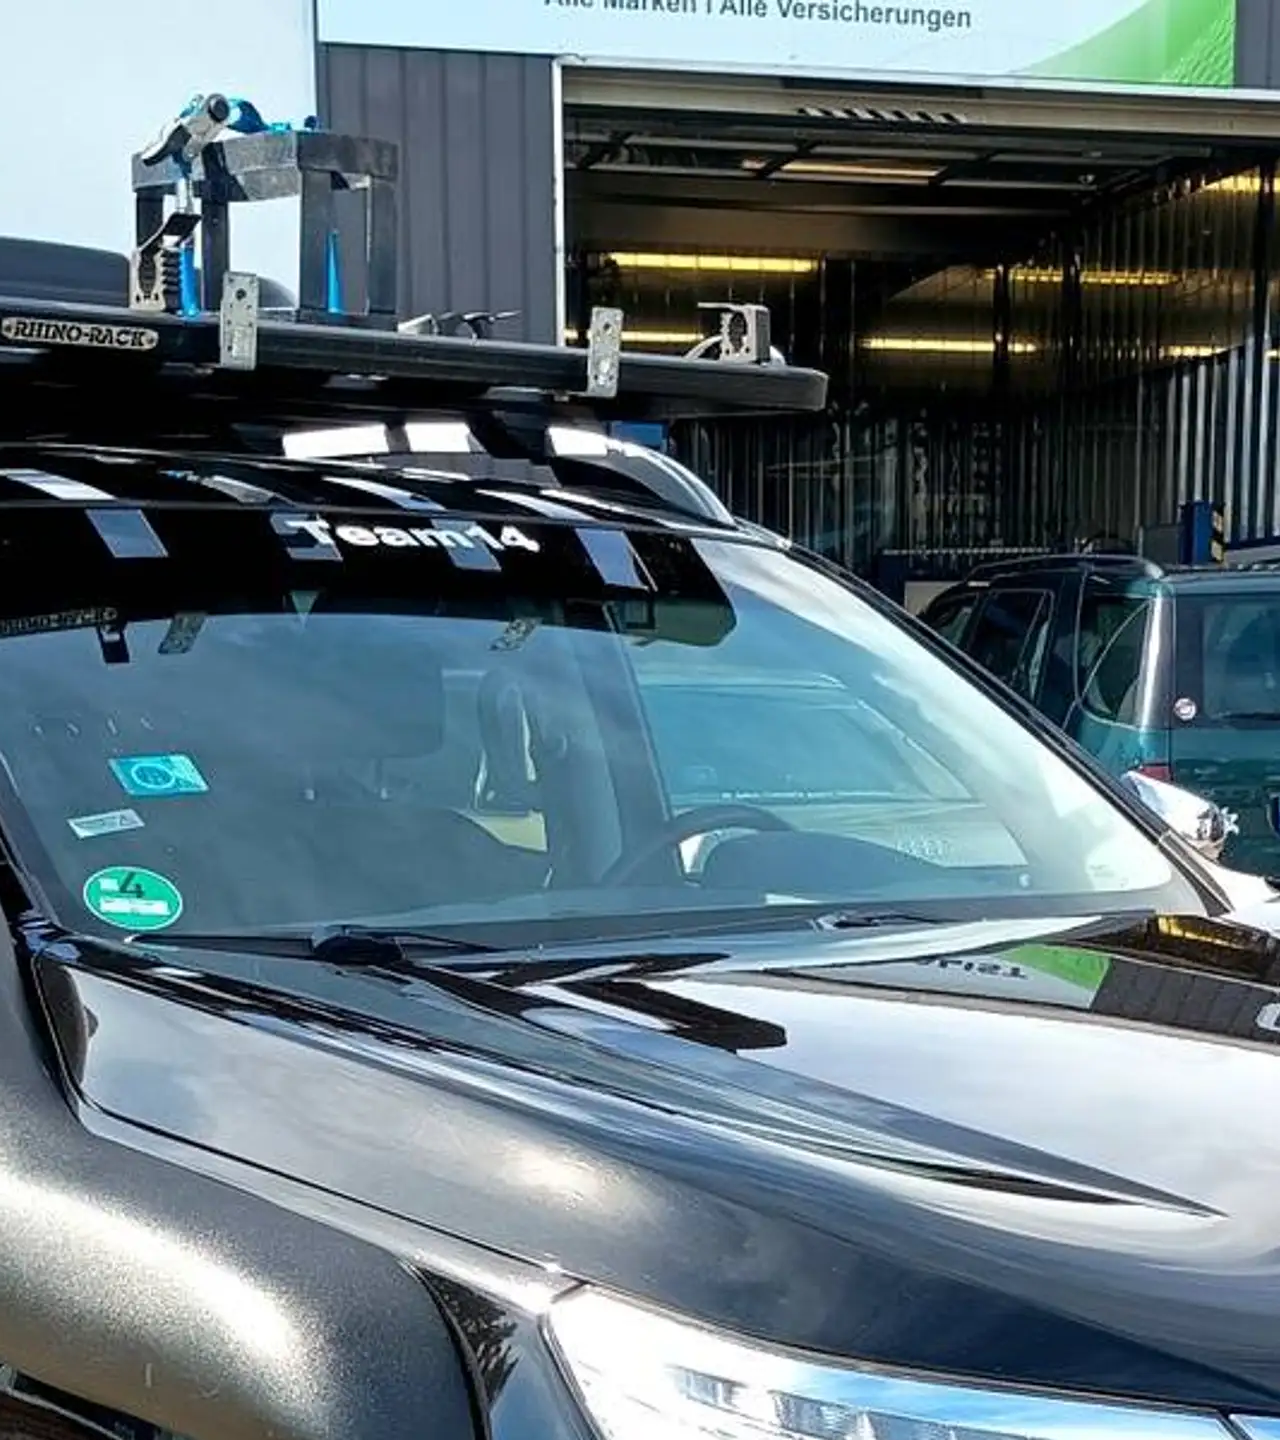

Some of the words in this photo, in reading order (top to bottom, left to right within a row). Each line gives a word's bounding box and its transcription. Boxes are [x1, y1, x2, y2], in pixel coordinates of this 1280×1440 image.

[777, 0, 971, 32] Versicherungen
[14, 319, 147, 347] RHINO-RACK
[120, 871, 145, 898] 4
